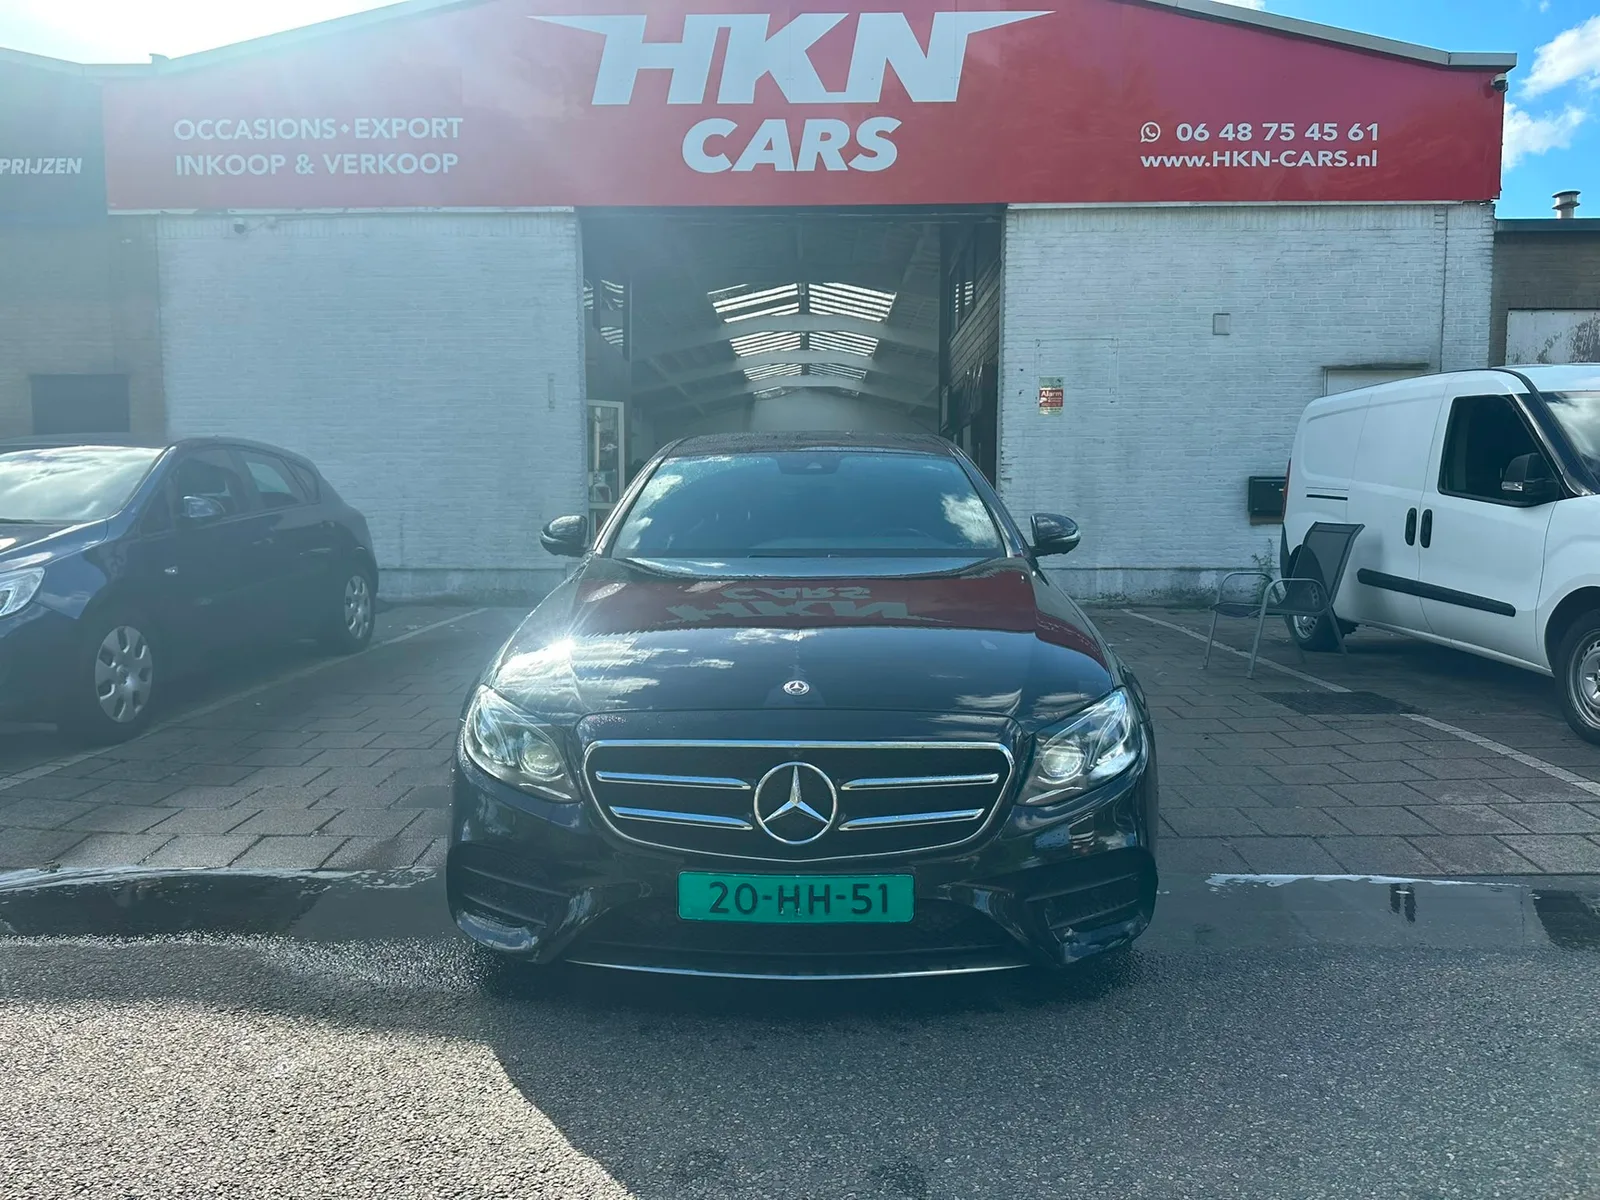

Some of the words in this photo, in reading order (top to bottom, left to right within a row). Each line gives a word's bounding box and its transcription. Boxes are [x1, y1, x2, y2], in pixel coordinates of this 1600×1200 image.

[527, 11, 1056, 105] HKN
[174, 118, 336, 140] OCCASIONS
[354, 117, 463, 139] EXPORT
[1176, 123, 1210, 141] 06
[1218, 123, 1252, 141] 48
[1262, 123, 1295, 141] 75
[1304, 123, 1338, 141] 45
[1347, 123, 1379, 141] 61
[682, 116, 902, 173] CARS
[0, 157, 82, 175] PRIJZEN
[175, 155, 286, 175] INKOOP
[295, 154, 315, 175] &
[324, 153, 459, 175] VERKOOP
[1140, 150, 1378, 167] www.HKN-CARS.nl
[709, 881, 888, 915] 20-HH-51
